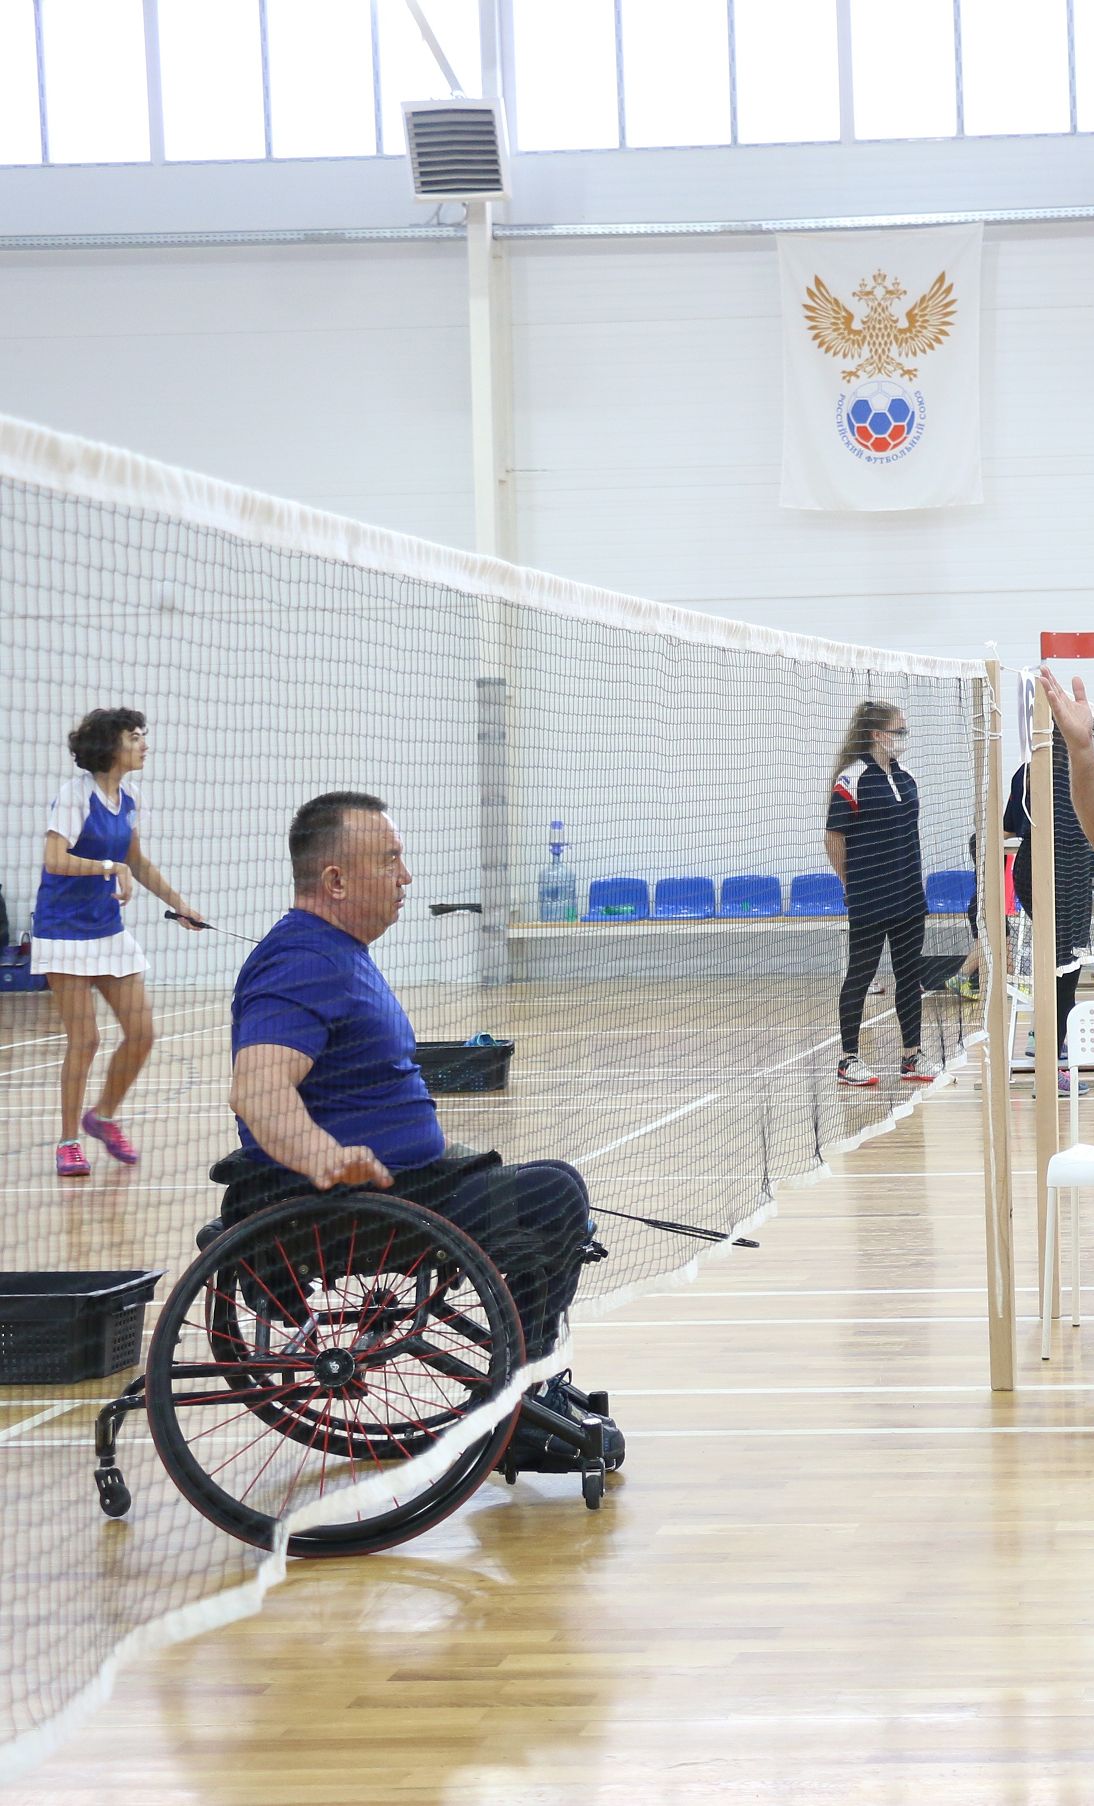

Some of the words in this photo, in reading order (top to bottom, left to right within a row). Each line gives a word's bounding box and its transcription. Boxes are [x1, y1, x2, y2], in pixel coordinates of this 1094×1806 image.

[914, 390, 926, 420] СОЮЗ
[836, 393, 864, 459] РОССИЙСКИЙ
[865, 423, 925, 464] ФУТБОЛЬНЫЙ
